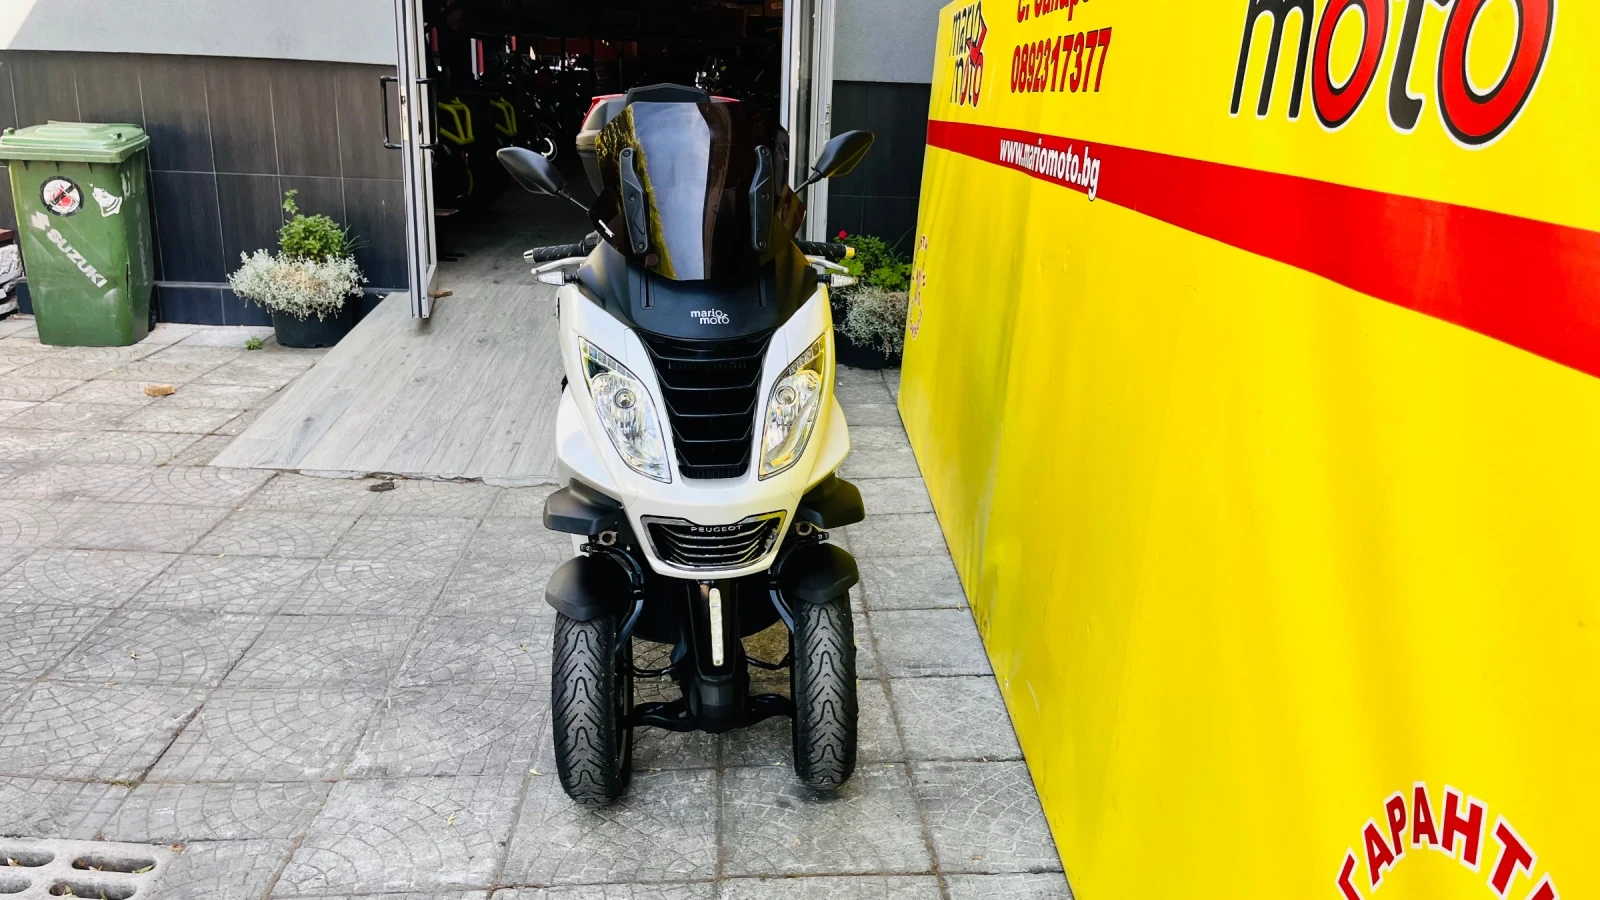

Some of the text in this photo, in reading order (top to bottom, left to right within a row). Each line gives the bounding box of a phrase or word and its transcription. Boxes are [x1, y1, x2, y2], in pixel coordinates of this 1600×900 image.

[949, 51, 983, 107] moto
[1010, 26, 1112, 93] 0892317377
[1229, 0, 1557, 150] moto
[1000, 138, 1101, 201] www.mariomoto.bg
[46, 229, 108, 288] SUZUKI
[690, 308, 723, 318] mario
[699, 316, 730, 325] moto
[690, 524, 743, 533] PEUGEOT
